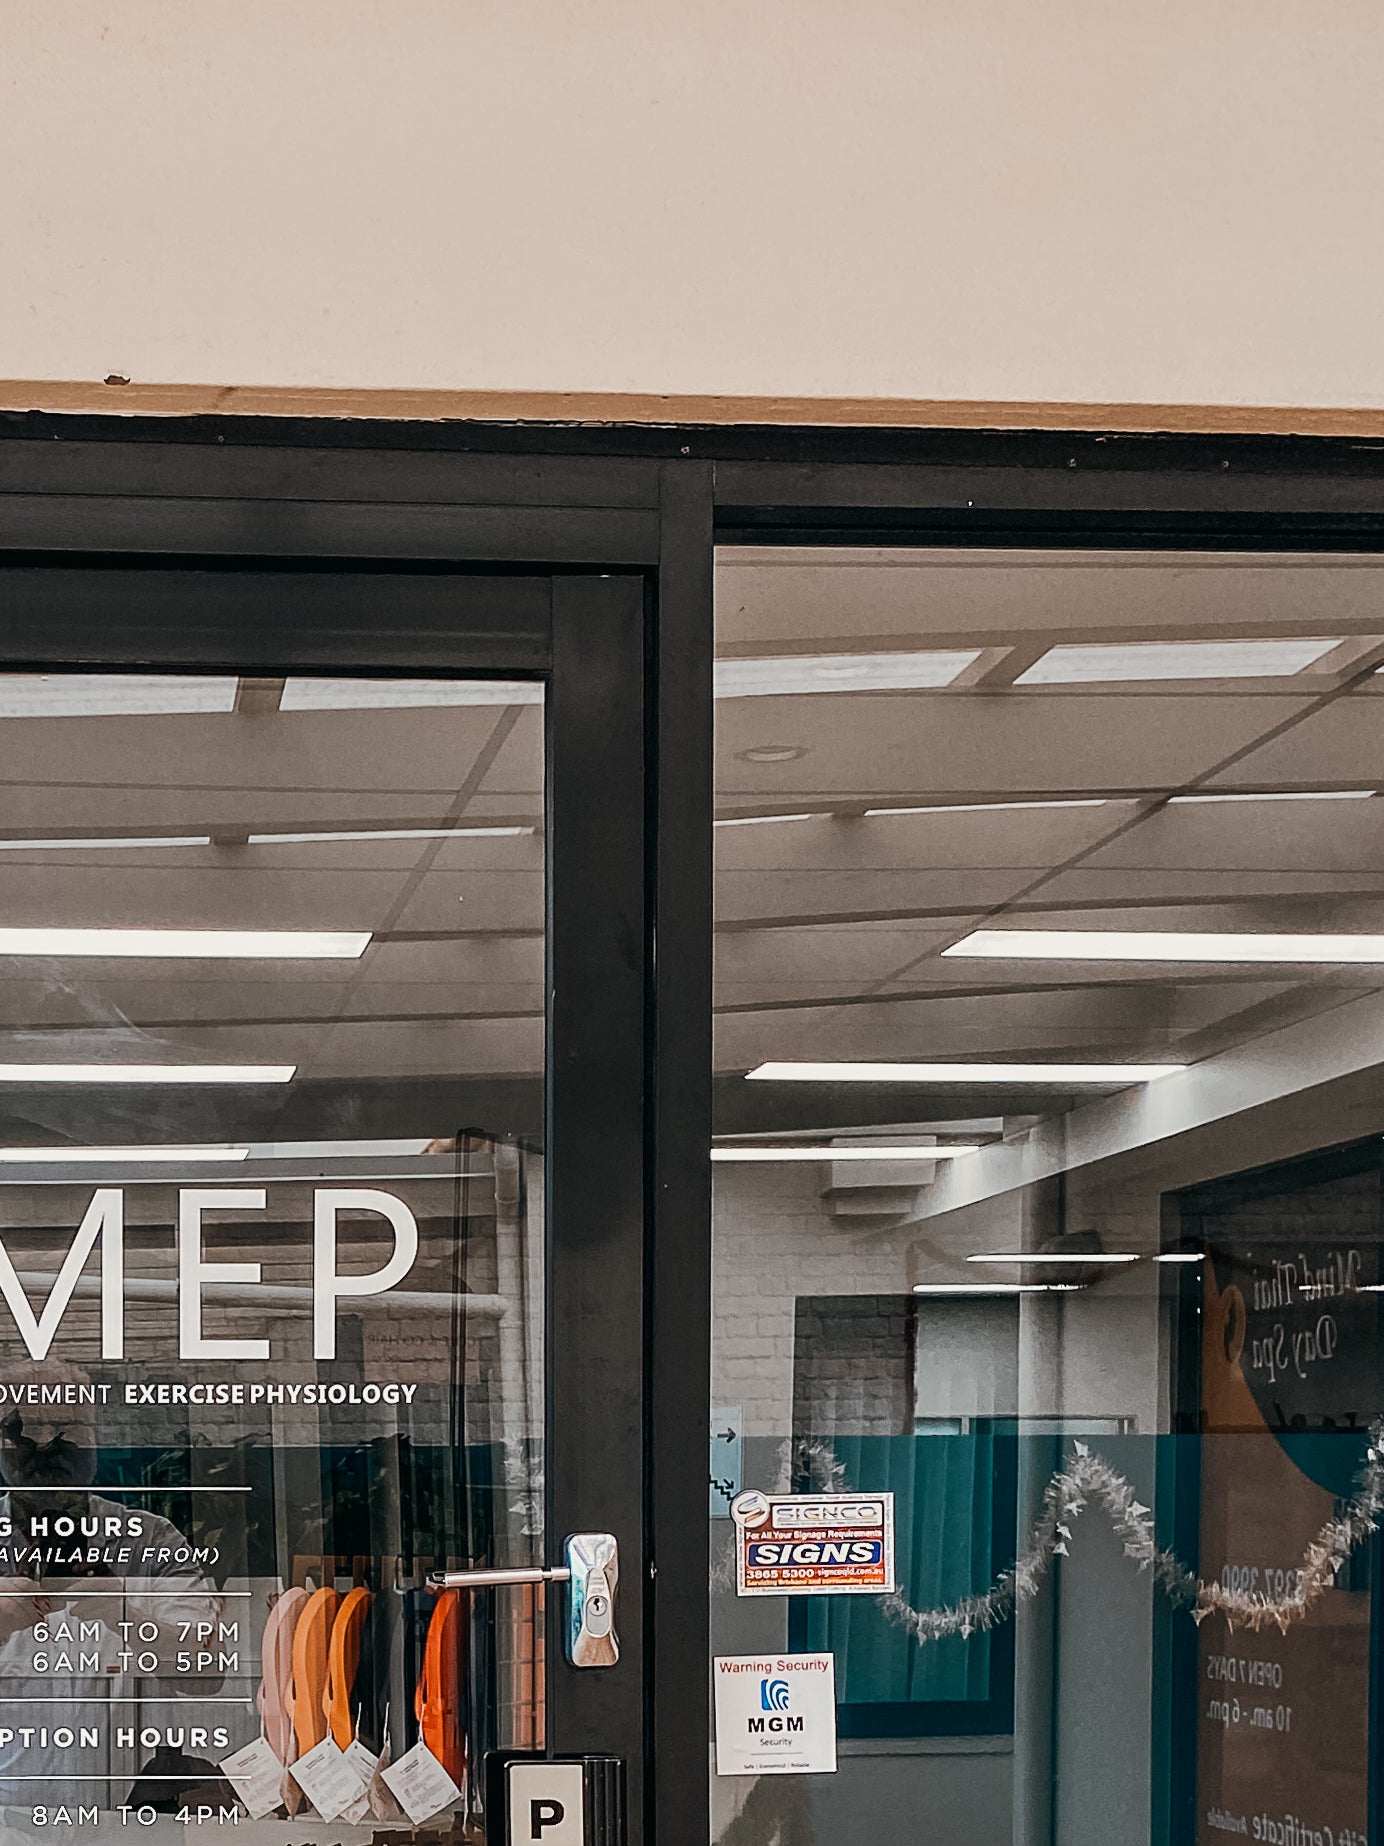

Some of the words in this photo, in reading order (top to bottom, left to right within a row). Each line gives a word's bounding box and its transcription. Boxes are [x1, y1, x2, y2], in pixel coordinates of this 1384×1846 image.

[124, 1383, 245, 1405] EXERCISE
[249, 1383, 418, 1405] PHYSIOLOGY
[776, 1506, 877, 1519] SIGNCO
[30, 1516, 145, 1538] HOURS
[141, 1546, 221, 1565] FROM)
[754, 1542, 875, 1566] SIGNS
[746, 1569, 778, 1579] 3865
[781, 1568, 815, 1579] 5300
[32, 1622, 101, 1642] 6AM
[118, 1622, 160, 1642] TO
[176, 1622, 240, 1642] 7PM
[32, 1652, 101, 1672] 6AM
[118, 1652, 160, 1672] TO
[175, 1652, 240, 1672] 5PM
[719, 1661, 773, 1675] Warning
[776, 1659, 829, 1674] Security
[747, 1716, 804, 1733] MGM
[116, 1727, 230, 1749] HOURS
[759, 1738, 793, 1747] Security
[32, 1805, 100, 1825] 8AM
[117, 1805, 158, 1825] TO
[174, 1805, 240, 1825] 4PM
